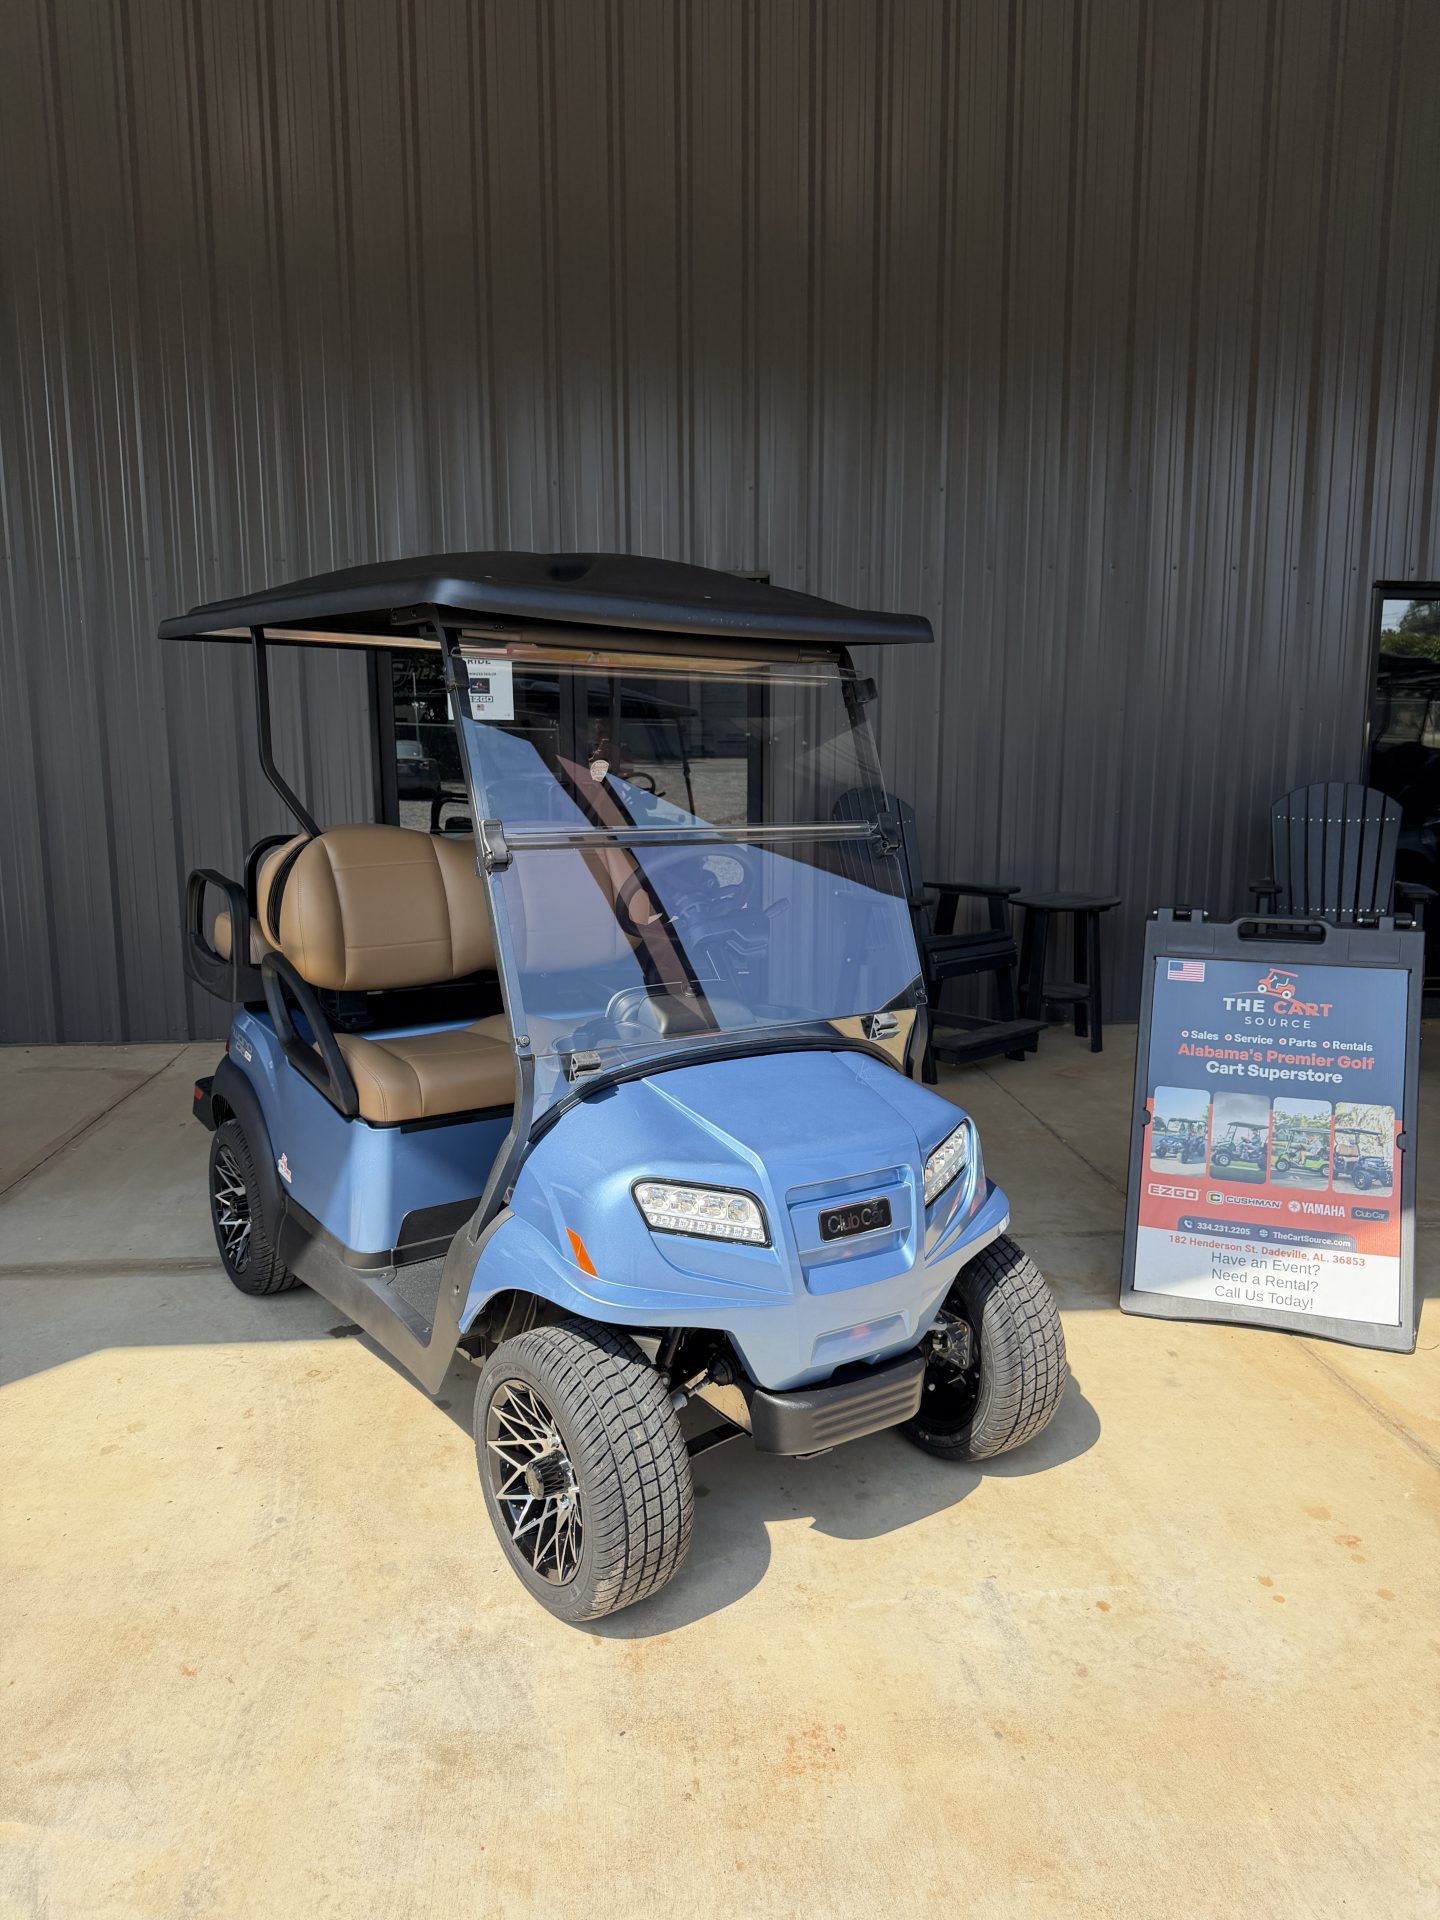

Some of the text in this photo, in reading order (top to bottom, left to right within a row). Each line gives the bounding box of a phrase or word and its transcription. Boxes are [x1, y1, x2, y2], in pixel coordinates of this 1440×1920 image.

[1223, 997, 1333, 1017] THE CART
[1244, 1016, 1311, 1029] SOURCE
[1190, 1030, 1373, 1052] Sales Service Parts Rentals
[1178, 1043, 1375, 1070] Alabama's Premier Golf
[1206, 1061, 1343, 1083] Cart Superstore
[1226, 1196, 1281, 1208] CUSHMAN
[1302, 1201, 1346, 1218] YAMAHA
[827, 1207, 884, 1233] Club Car
[1354, 1209, 1385, 1220] Club Car
[1197, 1222, 1351, 1247] 334.231.2205 TheCartSource.com
[1169, 1234, 1366, 1267] 182 Henderson St. Dadeville, AL. 36853
[1211, 1251, 1321, 1276] Have an Event?
[1211, 1268, 1319, 1292] Need a Rental?
[1214, 1285, 1314, 1311] Call Us Today!
